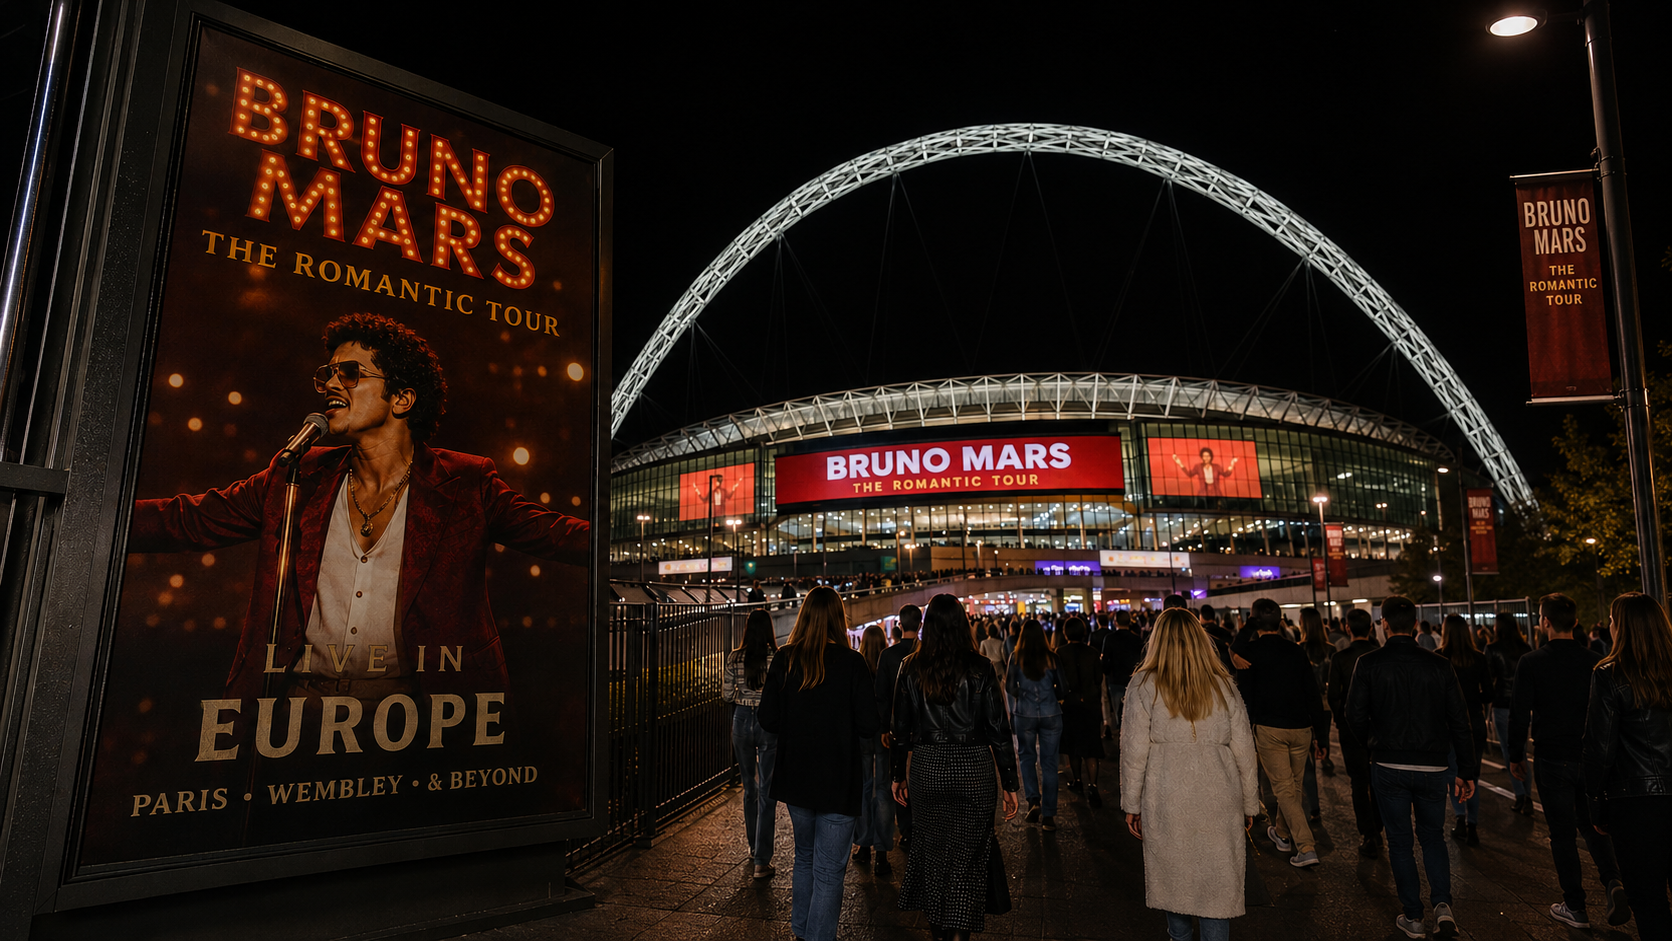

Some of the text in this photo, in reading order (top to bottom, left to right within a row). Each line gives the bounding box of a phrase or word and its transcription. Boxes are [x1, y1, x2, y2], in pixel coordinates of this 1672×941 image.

[228, 67, 555, 227] BRUNO
[245, 149, 536, 290] MARS
[1523, 198, 1591, 228] BRUNO
[1533, 226, 1587, 255] MARS
[202, 229, 560, 337] THE ROMANTIC TOUR
[1529, 278, 1598, 292] ROMANTIC
[1549, 264, 1575, 276] THE
[1546, 293, 1583, 306] TOUR
[826, 442, 1072, 481] BRUNO MARS
[853, 474, 1039, 493] THE ROMANTIC TOUR
[263, 644, 463, 673] LIVE IN
[194, 692, 506, 763] EUROPE
[130, 766, 538, 817] PARIS WEMBLEY & BEYOND
